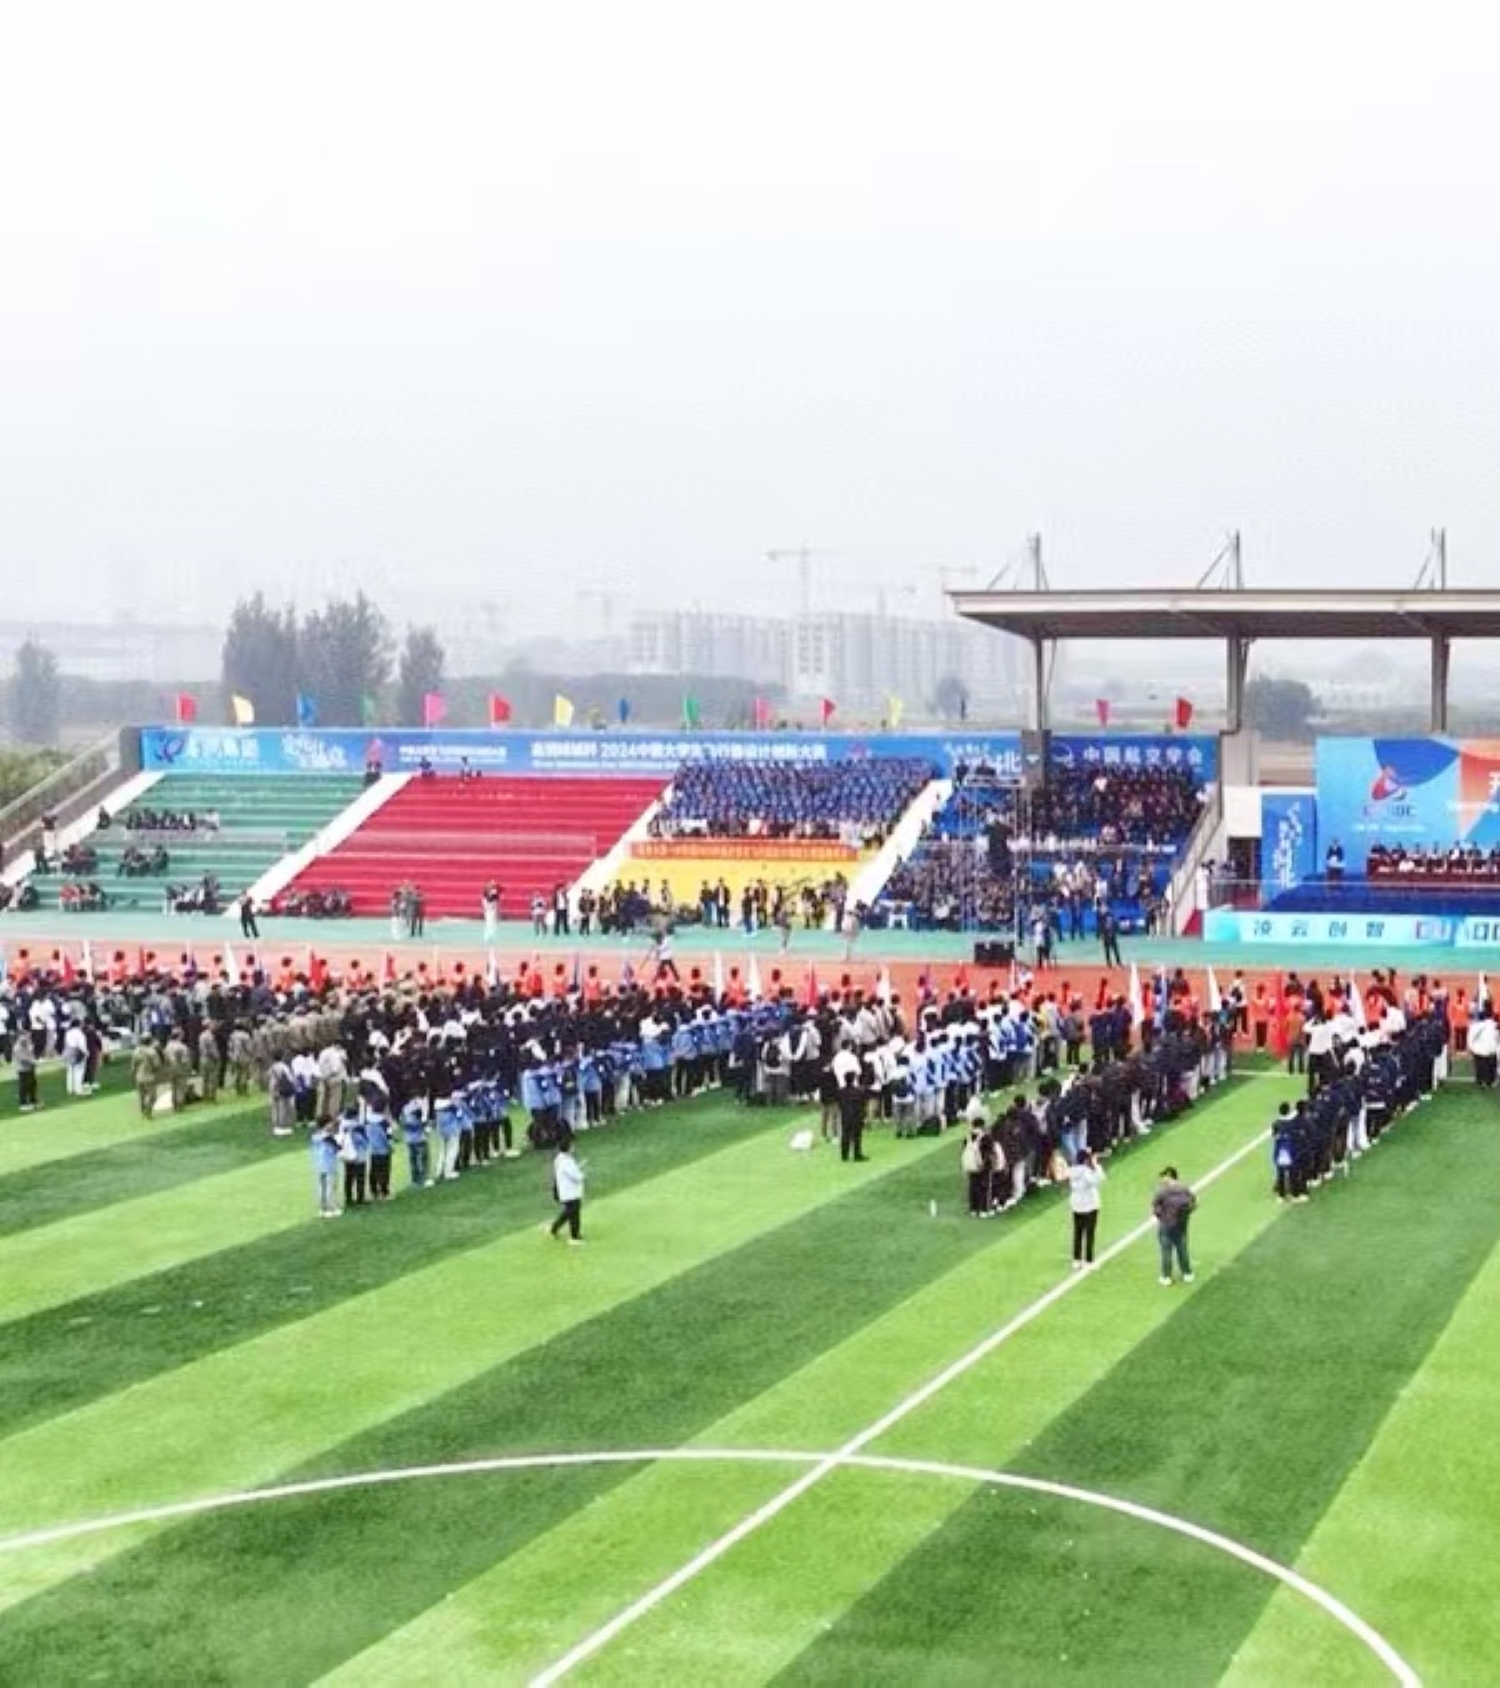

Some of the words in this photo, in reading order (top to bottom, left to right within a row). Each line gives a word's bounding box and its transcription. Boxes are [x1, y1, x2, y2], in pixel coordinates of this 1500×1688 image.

[1084, 745, 1202, 765] 中国航空学会
